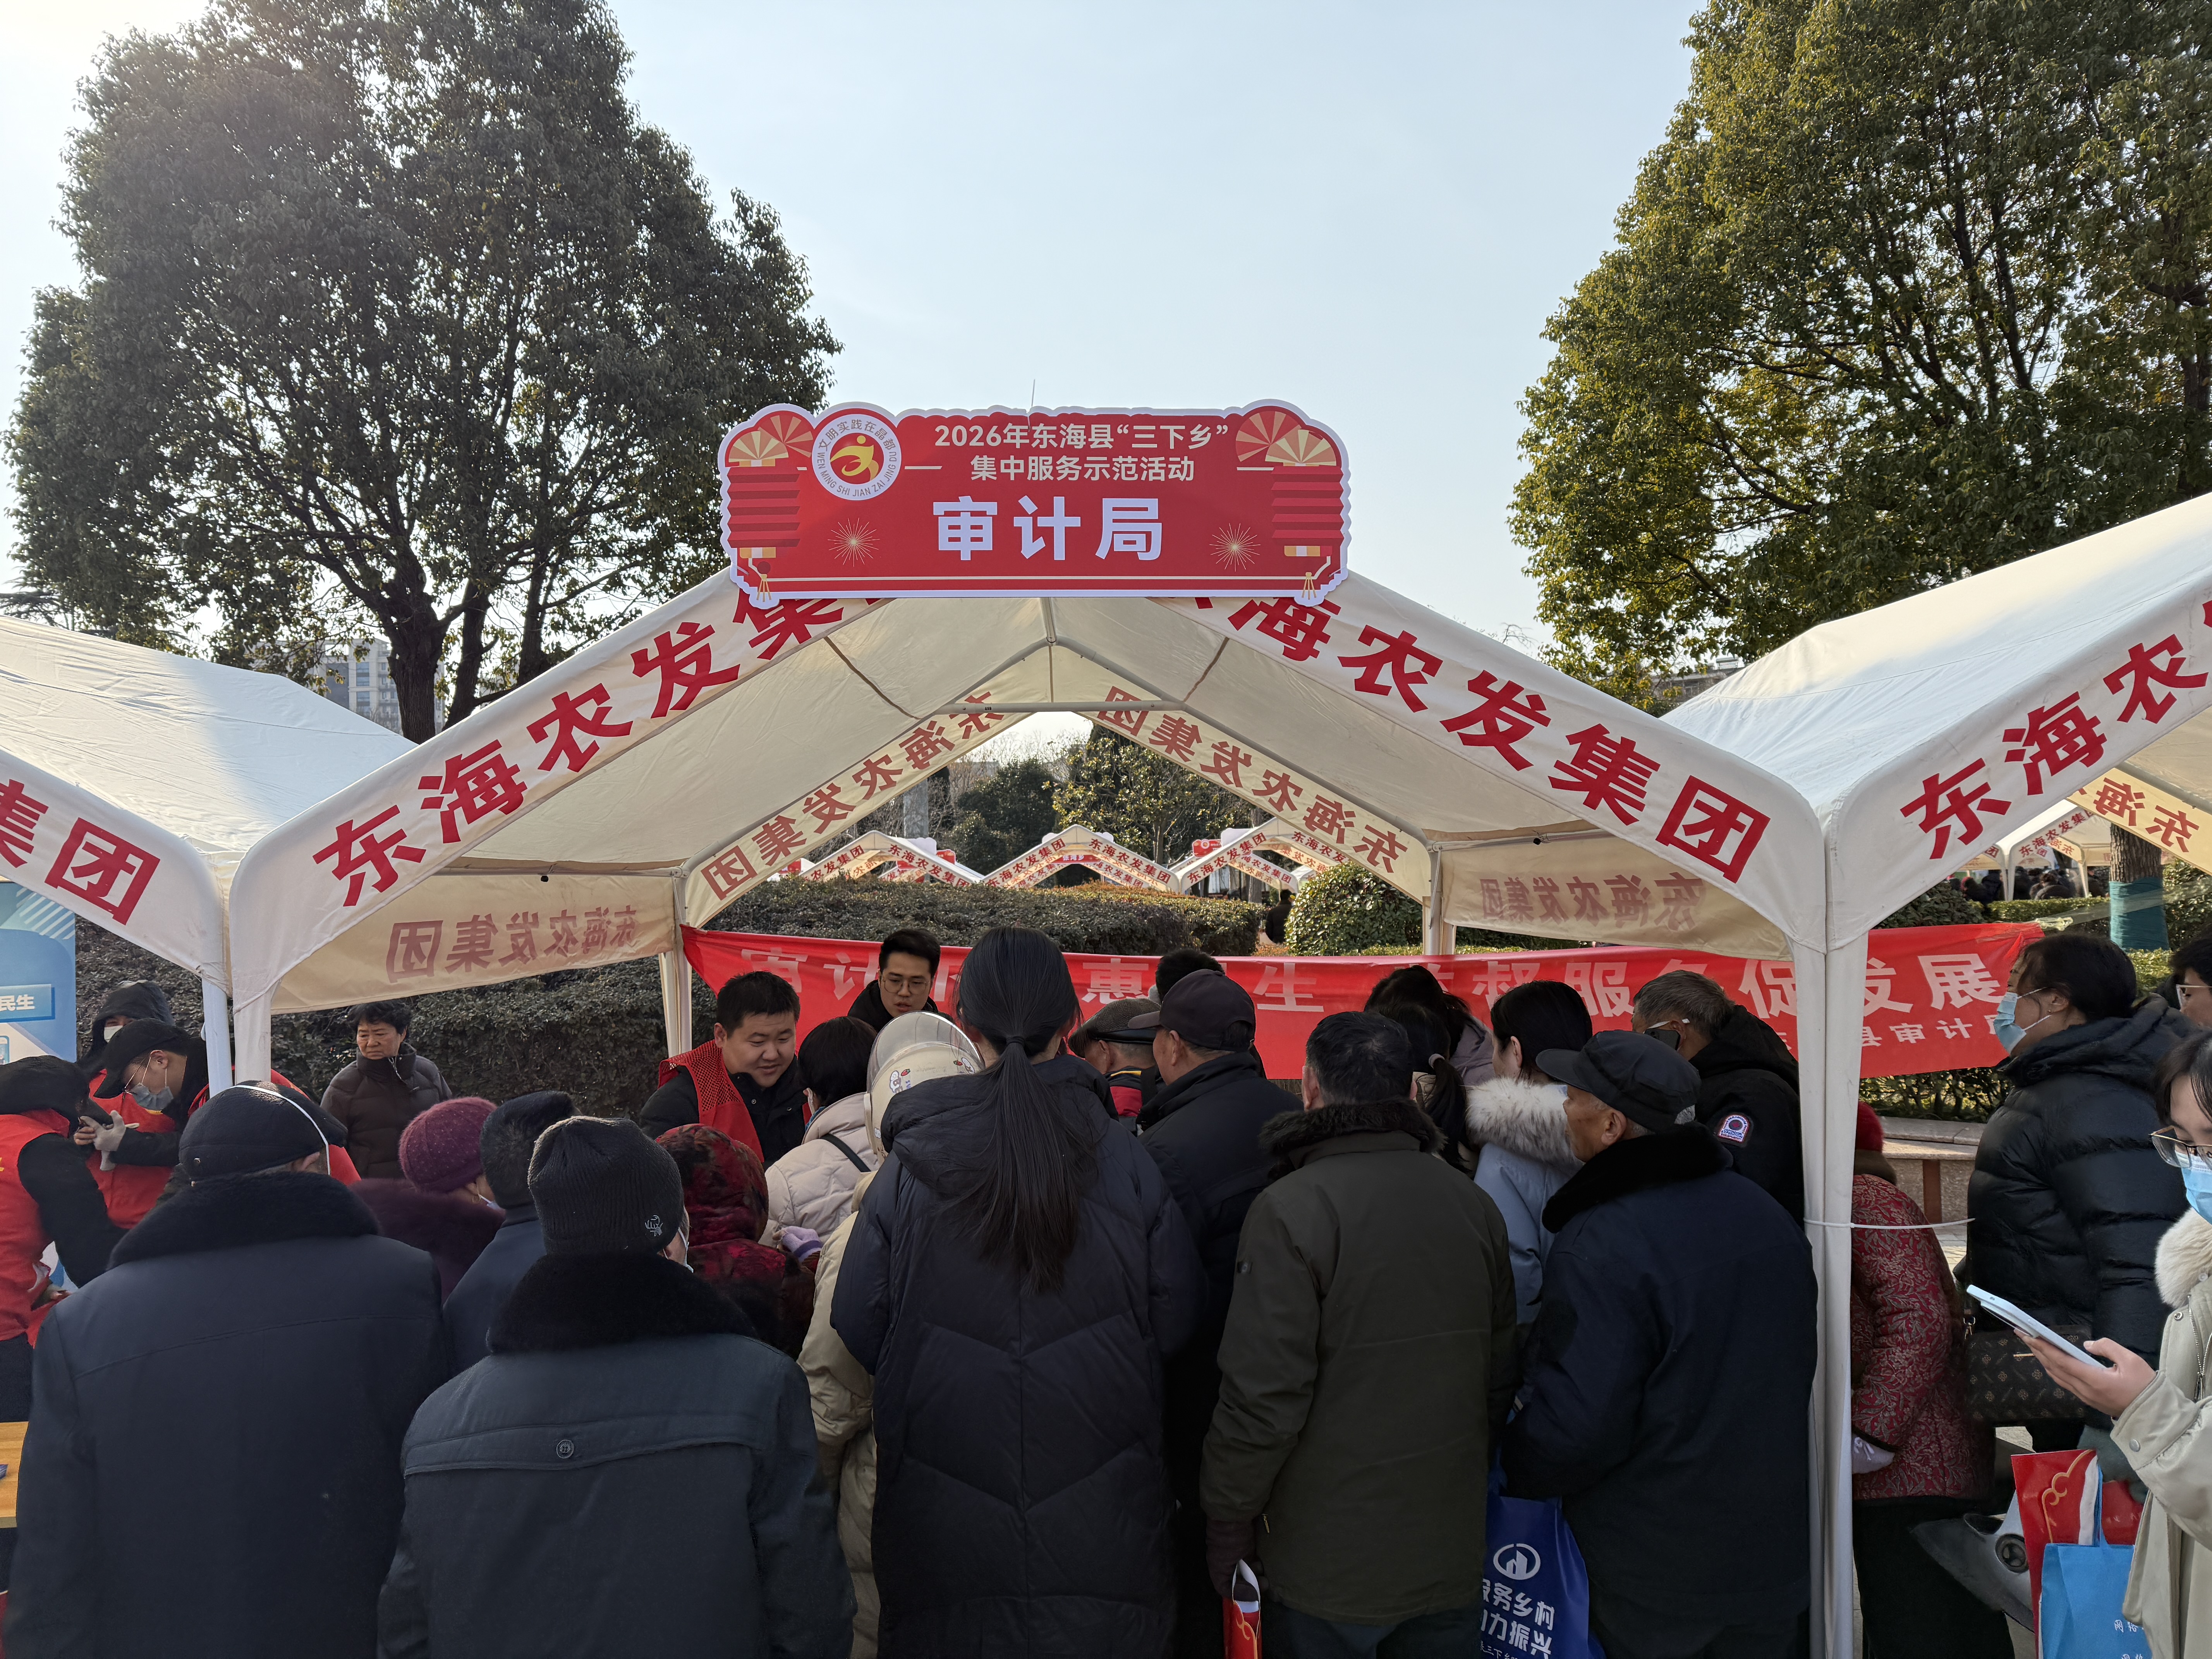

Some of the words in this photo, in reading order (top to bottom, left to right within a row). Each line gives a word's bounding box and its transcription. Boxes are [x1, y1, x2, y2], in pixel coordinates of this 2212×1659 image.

[818, 419, 896, 452] 文明实践在晶都
[934, 423, 1228, 449] 2026年东海县“三下乡”
[817, 452, 826, 469] WEN
[889, 452, 897, 462] DU
[970, 455, 1194, 481] 集中服务示范活动
[820, 470, 837, 488] MING
[884, 464, 896, 481] JING
[836, 485, 850, 496] SHI
[853, 487, 871, 497] JIAN
[872, 480, 886, 492] ZAI
[933, 495, 1162, 560] 审计局
[1195, 597, 1771, 883] 海农发集团
[1900, 600, 2212, 859] 东海农
[312, 588, 884, 907] 东海农发集
[1089, 838, 1171, 884] 东海农发集团
[1187, 832, 1267, 884] 东海农发集团
[0, 994, 35, 1012] 民生
